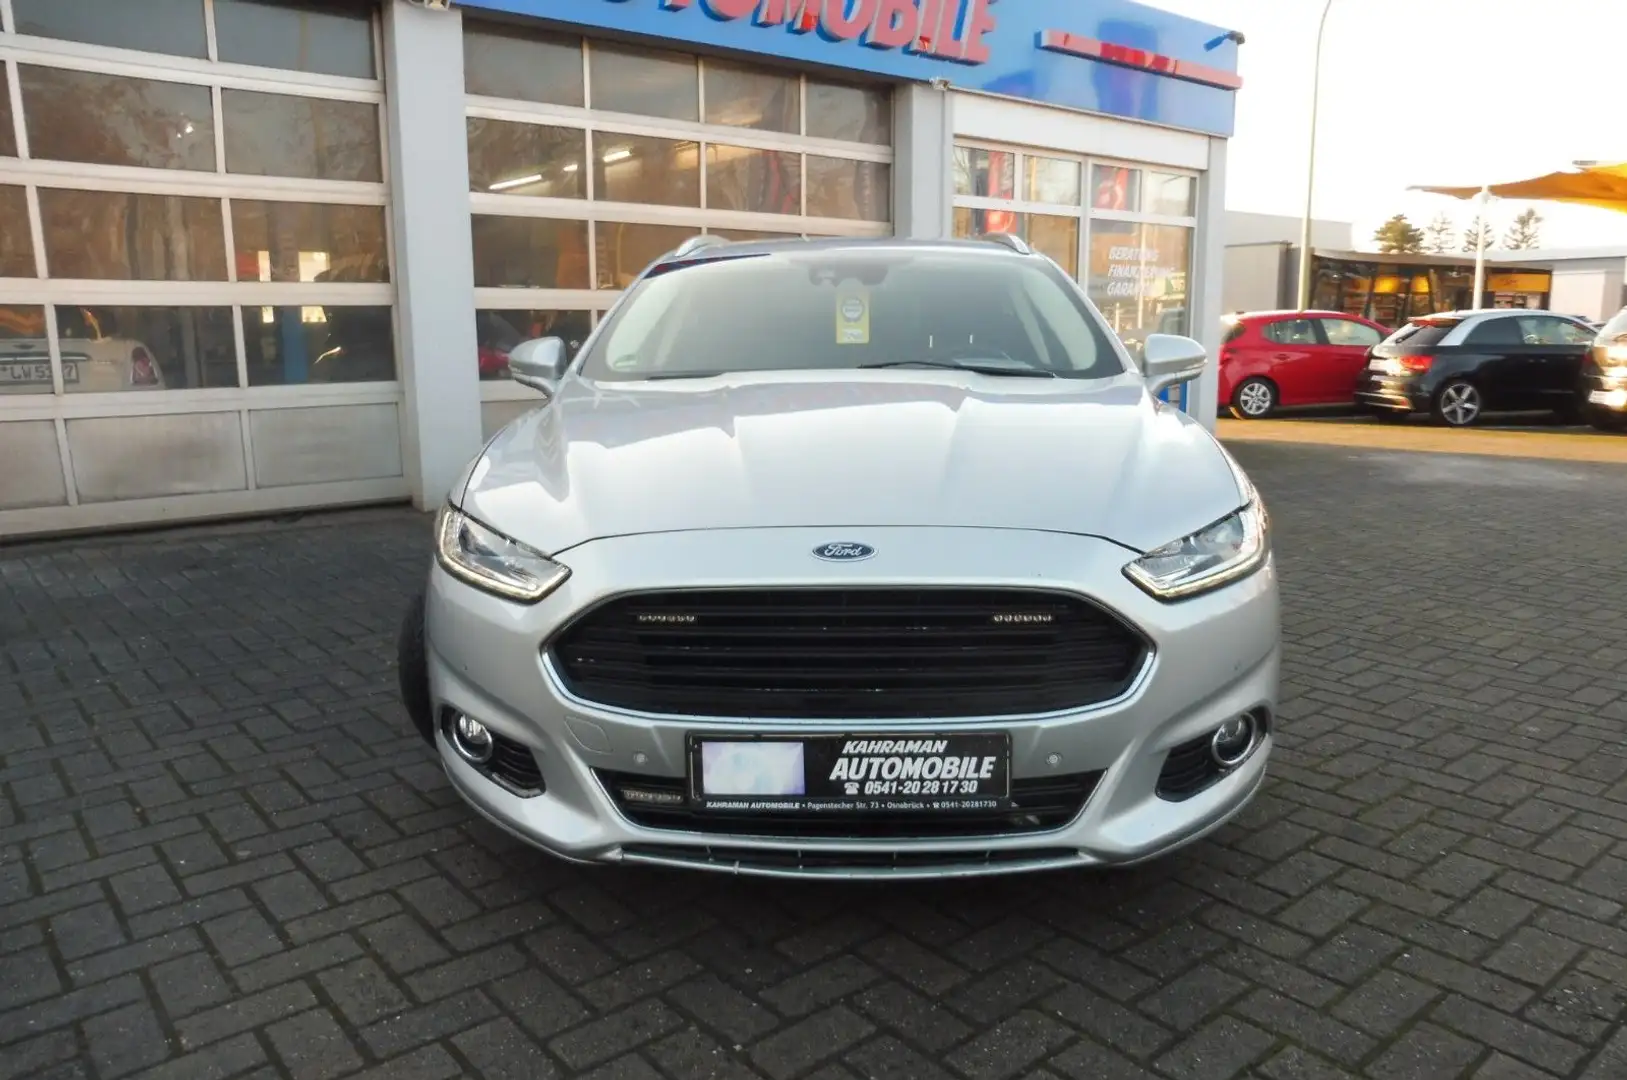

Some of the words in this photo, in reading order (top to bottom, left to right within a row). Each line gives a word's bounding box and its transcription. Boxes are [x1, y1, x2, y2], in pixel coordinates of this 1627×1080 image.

[824, 543, 862, 556] Ford
[842, 740, 948, 754] KAHRAMAN
[829, 756, 996, 780] AUTOMOBILE
[864, 781, 921, 794] 0541-20
[706, 801, 749, 809] KAHRAMAN
[750, 801, 800, 809] AUTOMOBILE
[856, 801, 868, 809] Str.
[886, 801, 924, 809] Osnabrück
